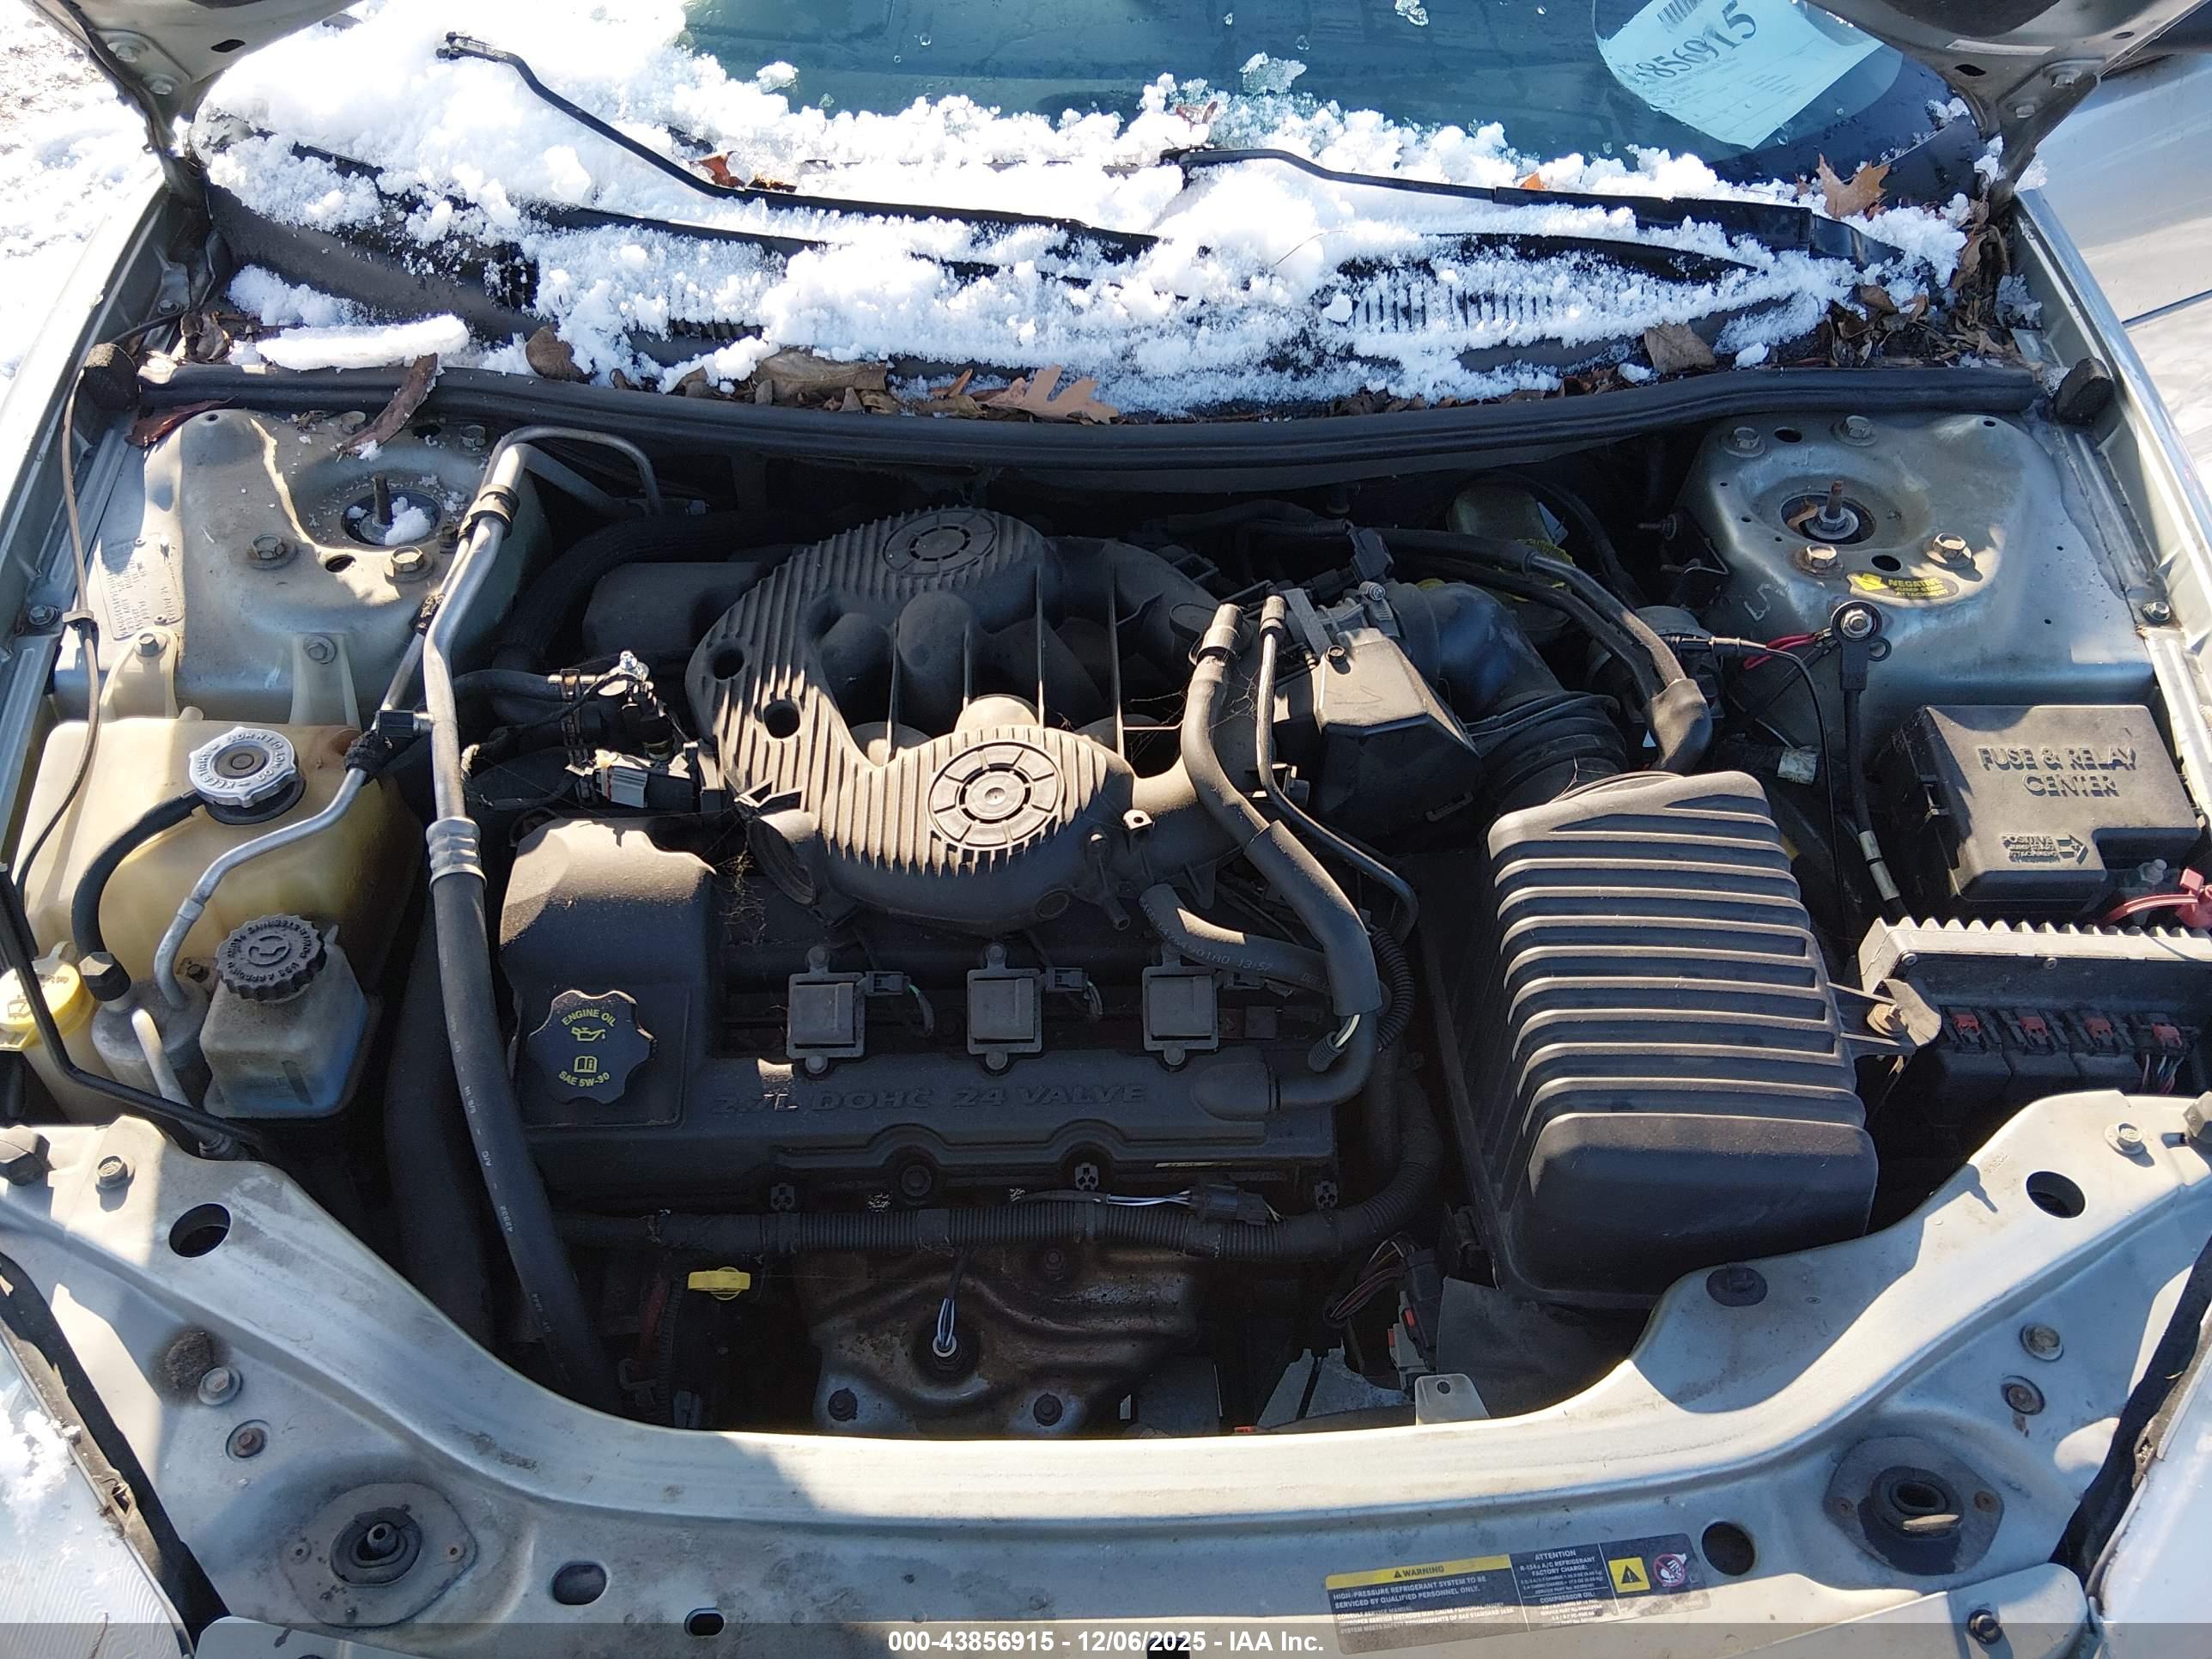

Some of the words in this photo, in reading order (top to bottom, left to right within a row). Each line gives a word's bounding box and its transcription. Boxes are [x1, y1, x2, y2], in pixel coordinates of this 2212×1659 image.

[1888, 578, 1942, 587] NEGATIVE
[1978, 747, 2037, 771] FUSE
[2042, 747, 2063, 770] &
[2067, 747, 2136, 770] RELAY
[2022, 774, 2119, 798] CENTER
[561, 1008, 599, 1026] ENGINE
[601, 1012, 617, 1028] OIL
[559, 1071, 577, 1086] SAE
[579, 1072, 610, 1087] 5W-30
[811, 1088, 933, 1112] DOHC
[953, 1087, 1006, 1108] 24
[1018, 1084, 1148, 1105] VALVE
[1534, 1550, 1576, 1560] ATTENTION
[1554, 1557, 1595, 1566] REFRIGERANT
[1402, 1565, 1444, 1577] WARNING
[1333, 1589, 1389, 1599] HIGH-PRESSURE
[1390, 1582, 1437, 1592] REFRIGERANT
[1438, 1577, 1465, 1587] SYSTEM
[1334, 1599, 1368, 1608] SERVICED
[1380, 1593, 1417, 1603] QUALIFIED
[1418, 1588, 1459, 1598] PERSONNEL
[1539, 1594, 1582, 1602] COMPRESSOR
